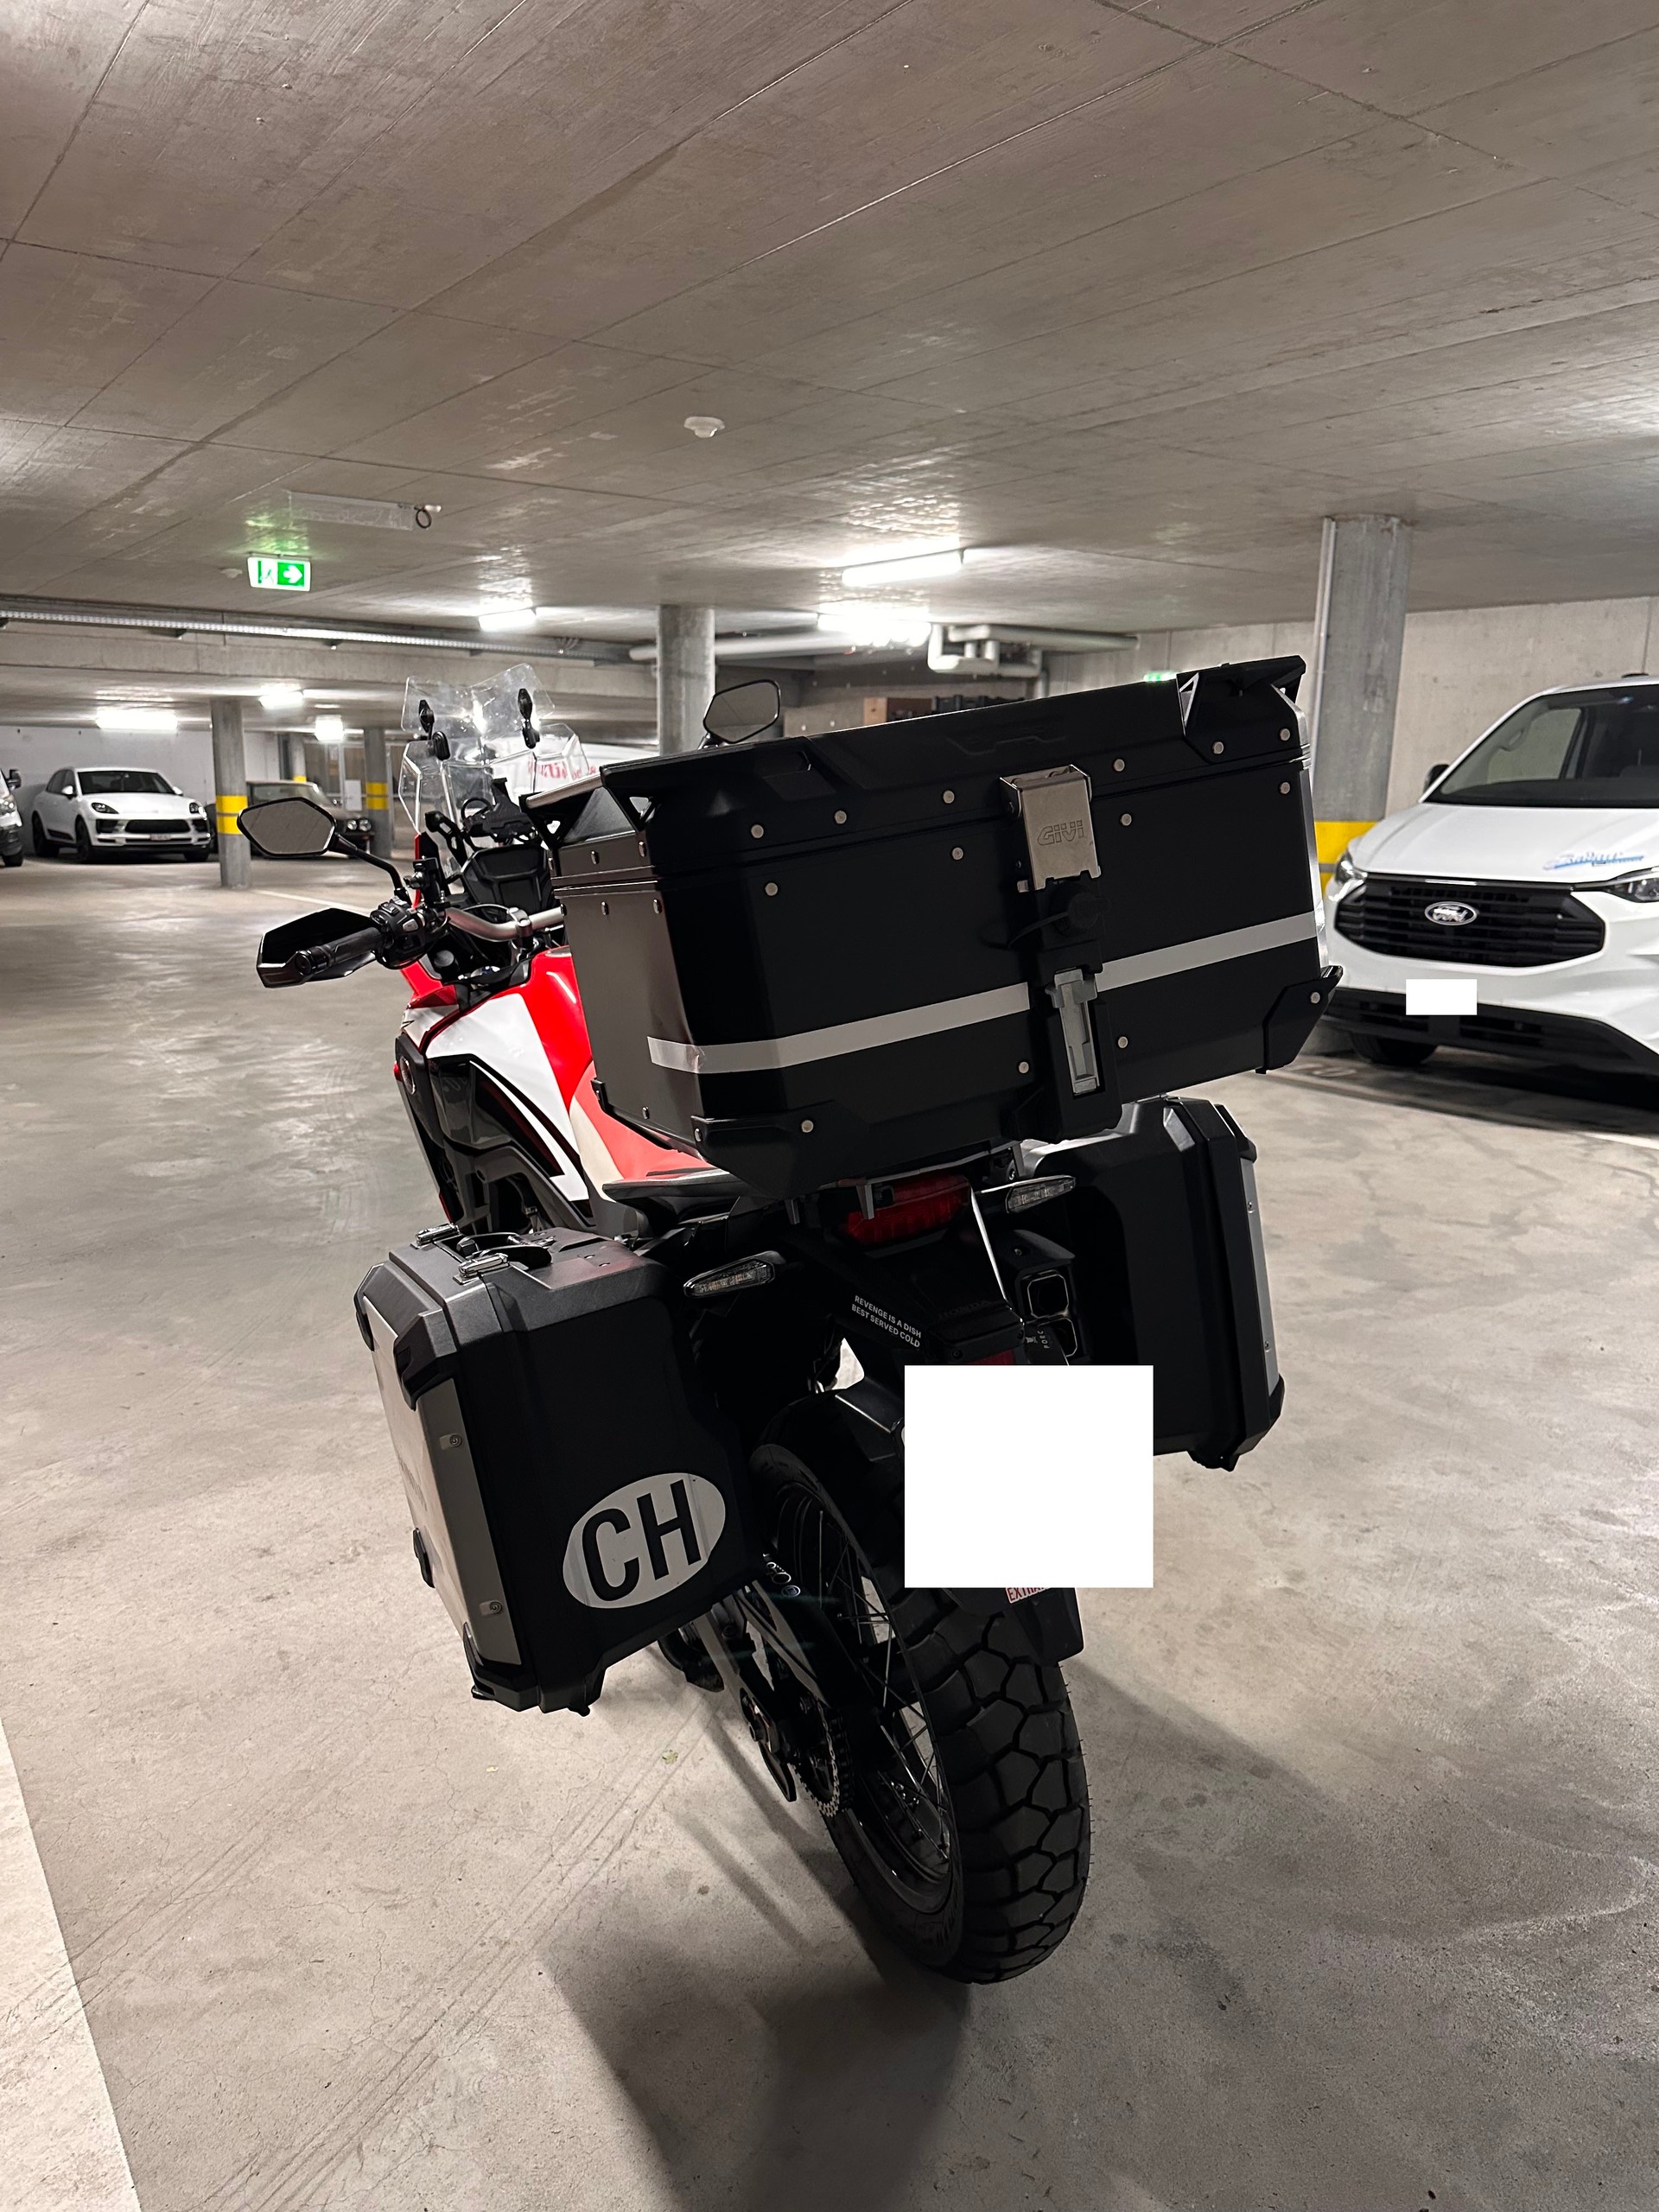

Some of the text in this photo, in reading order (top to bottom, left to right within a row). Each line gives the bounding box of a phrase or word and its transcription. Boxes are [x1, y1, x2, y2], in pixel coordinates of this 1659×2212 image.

[851, 1303, 920, 1348] BEST SERVED COLD
[854, 1295, 922, 1338] REVENGE IS A DISH
[582, 1479, 702, 1601] CH
